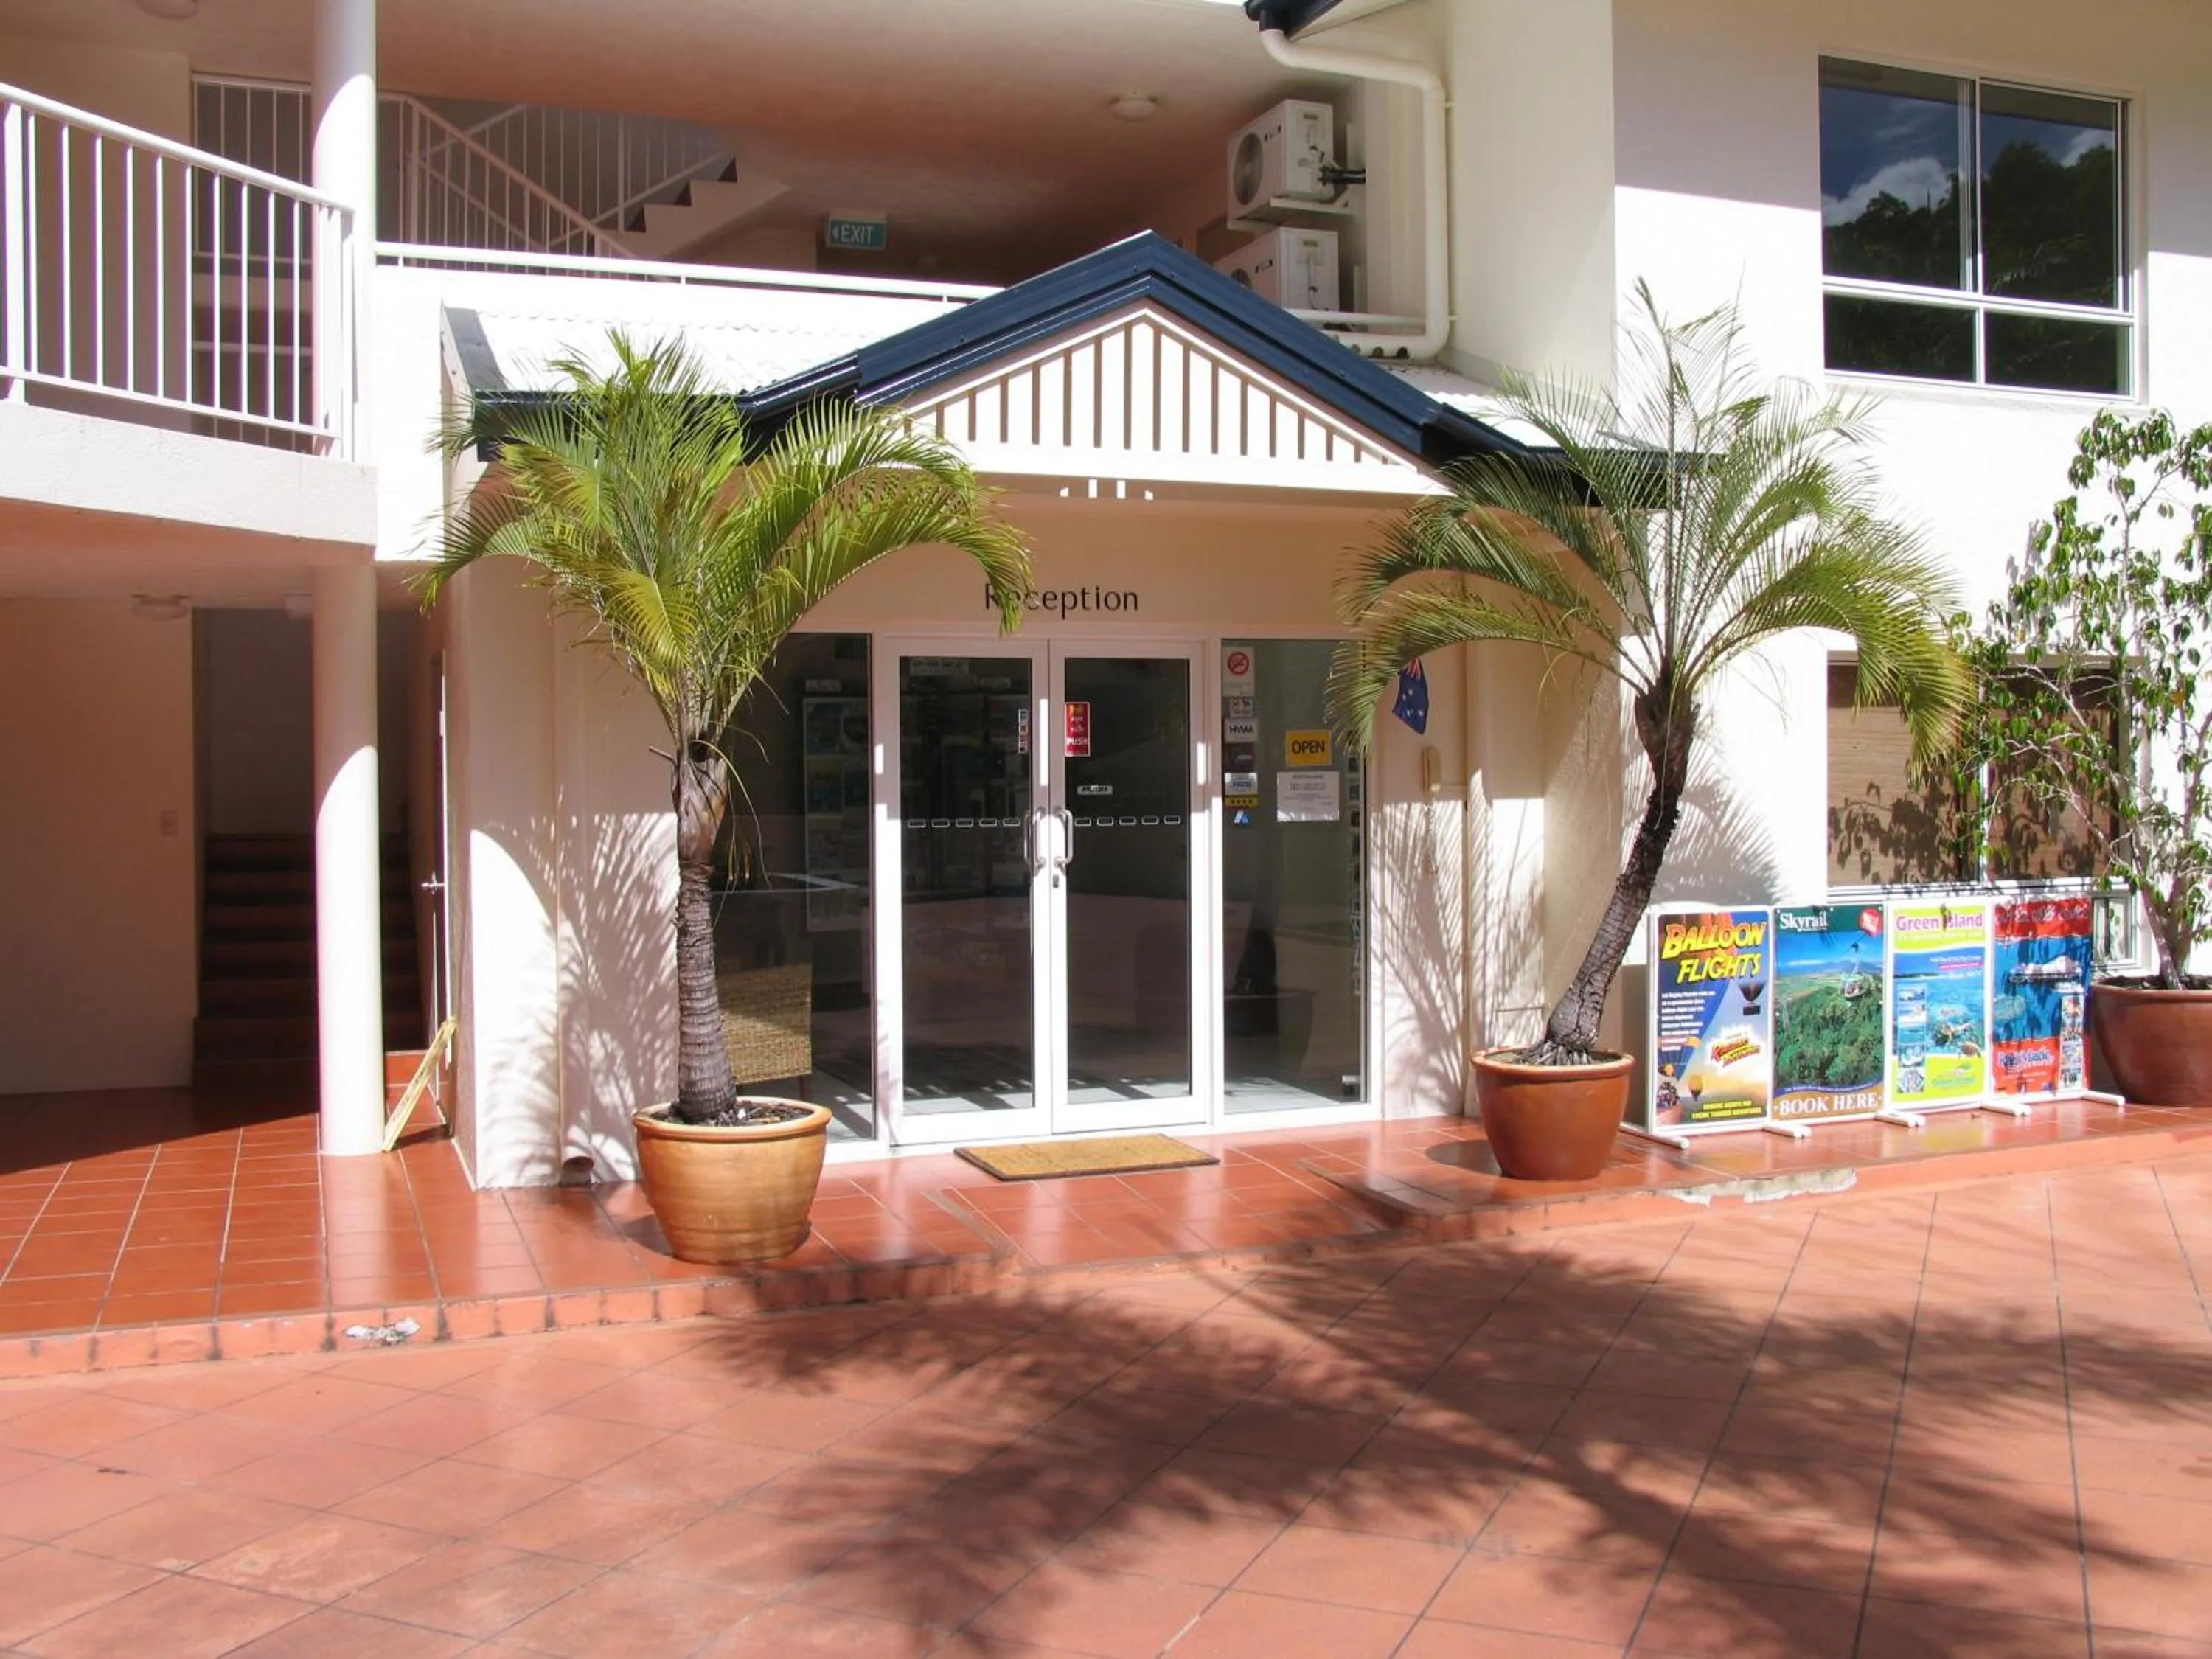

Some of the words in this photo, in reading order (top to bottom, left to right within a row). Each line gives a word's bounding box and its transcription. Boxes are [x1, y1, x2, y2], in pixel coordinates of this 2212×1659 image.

[841, 224, 874, 243] EXIT
[1291, 740, 1325, 754] OPEN
[1779, 911, 1828, 932] Skyrail
[1896, 915, 1939, 931] Green
[1941, 914, 1983, 929] sland
[1662, 922, 1767, 959] BALLOON
[1677, 953, 1761, 984] FLIGHTS
[1779, 1096, 1829, 1116] BOOK
[1833, 1092, 1877, 1111] HERE
